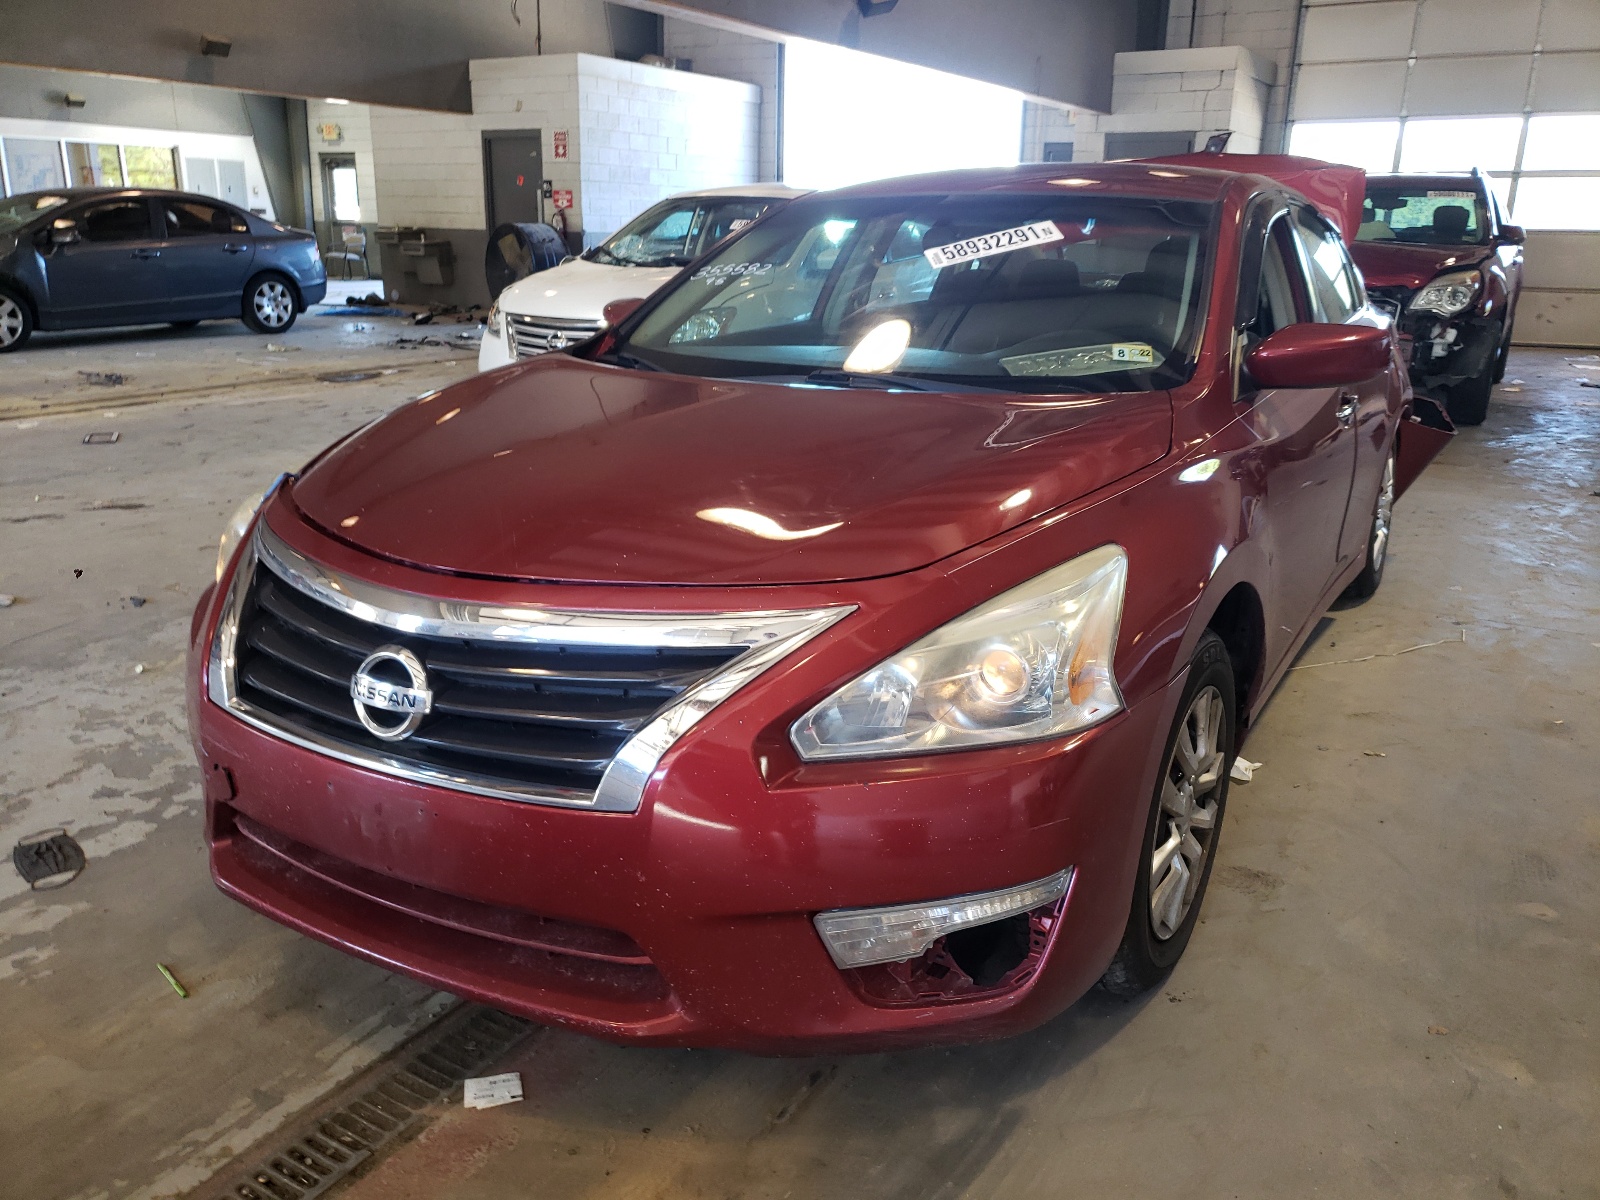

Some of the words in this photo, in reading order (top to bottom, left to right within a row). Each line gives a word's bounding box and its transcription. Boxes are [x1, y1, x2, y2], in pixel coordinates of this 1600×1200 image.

[941, 226, 1041, 260] 58932291
[1041, 227, 1054, 236] N
[1117, 349, 1126, 358] 8
[1139, 349, 1152, 357] 22
[353, 679, 417, 711] NISSAN
